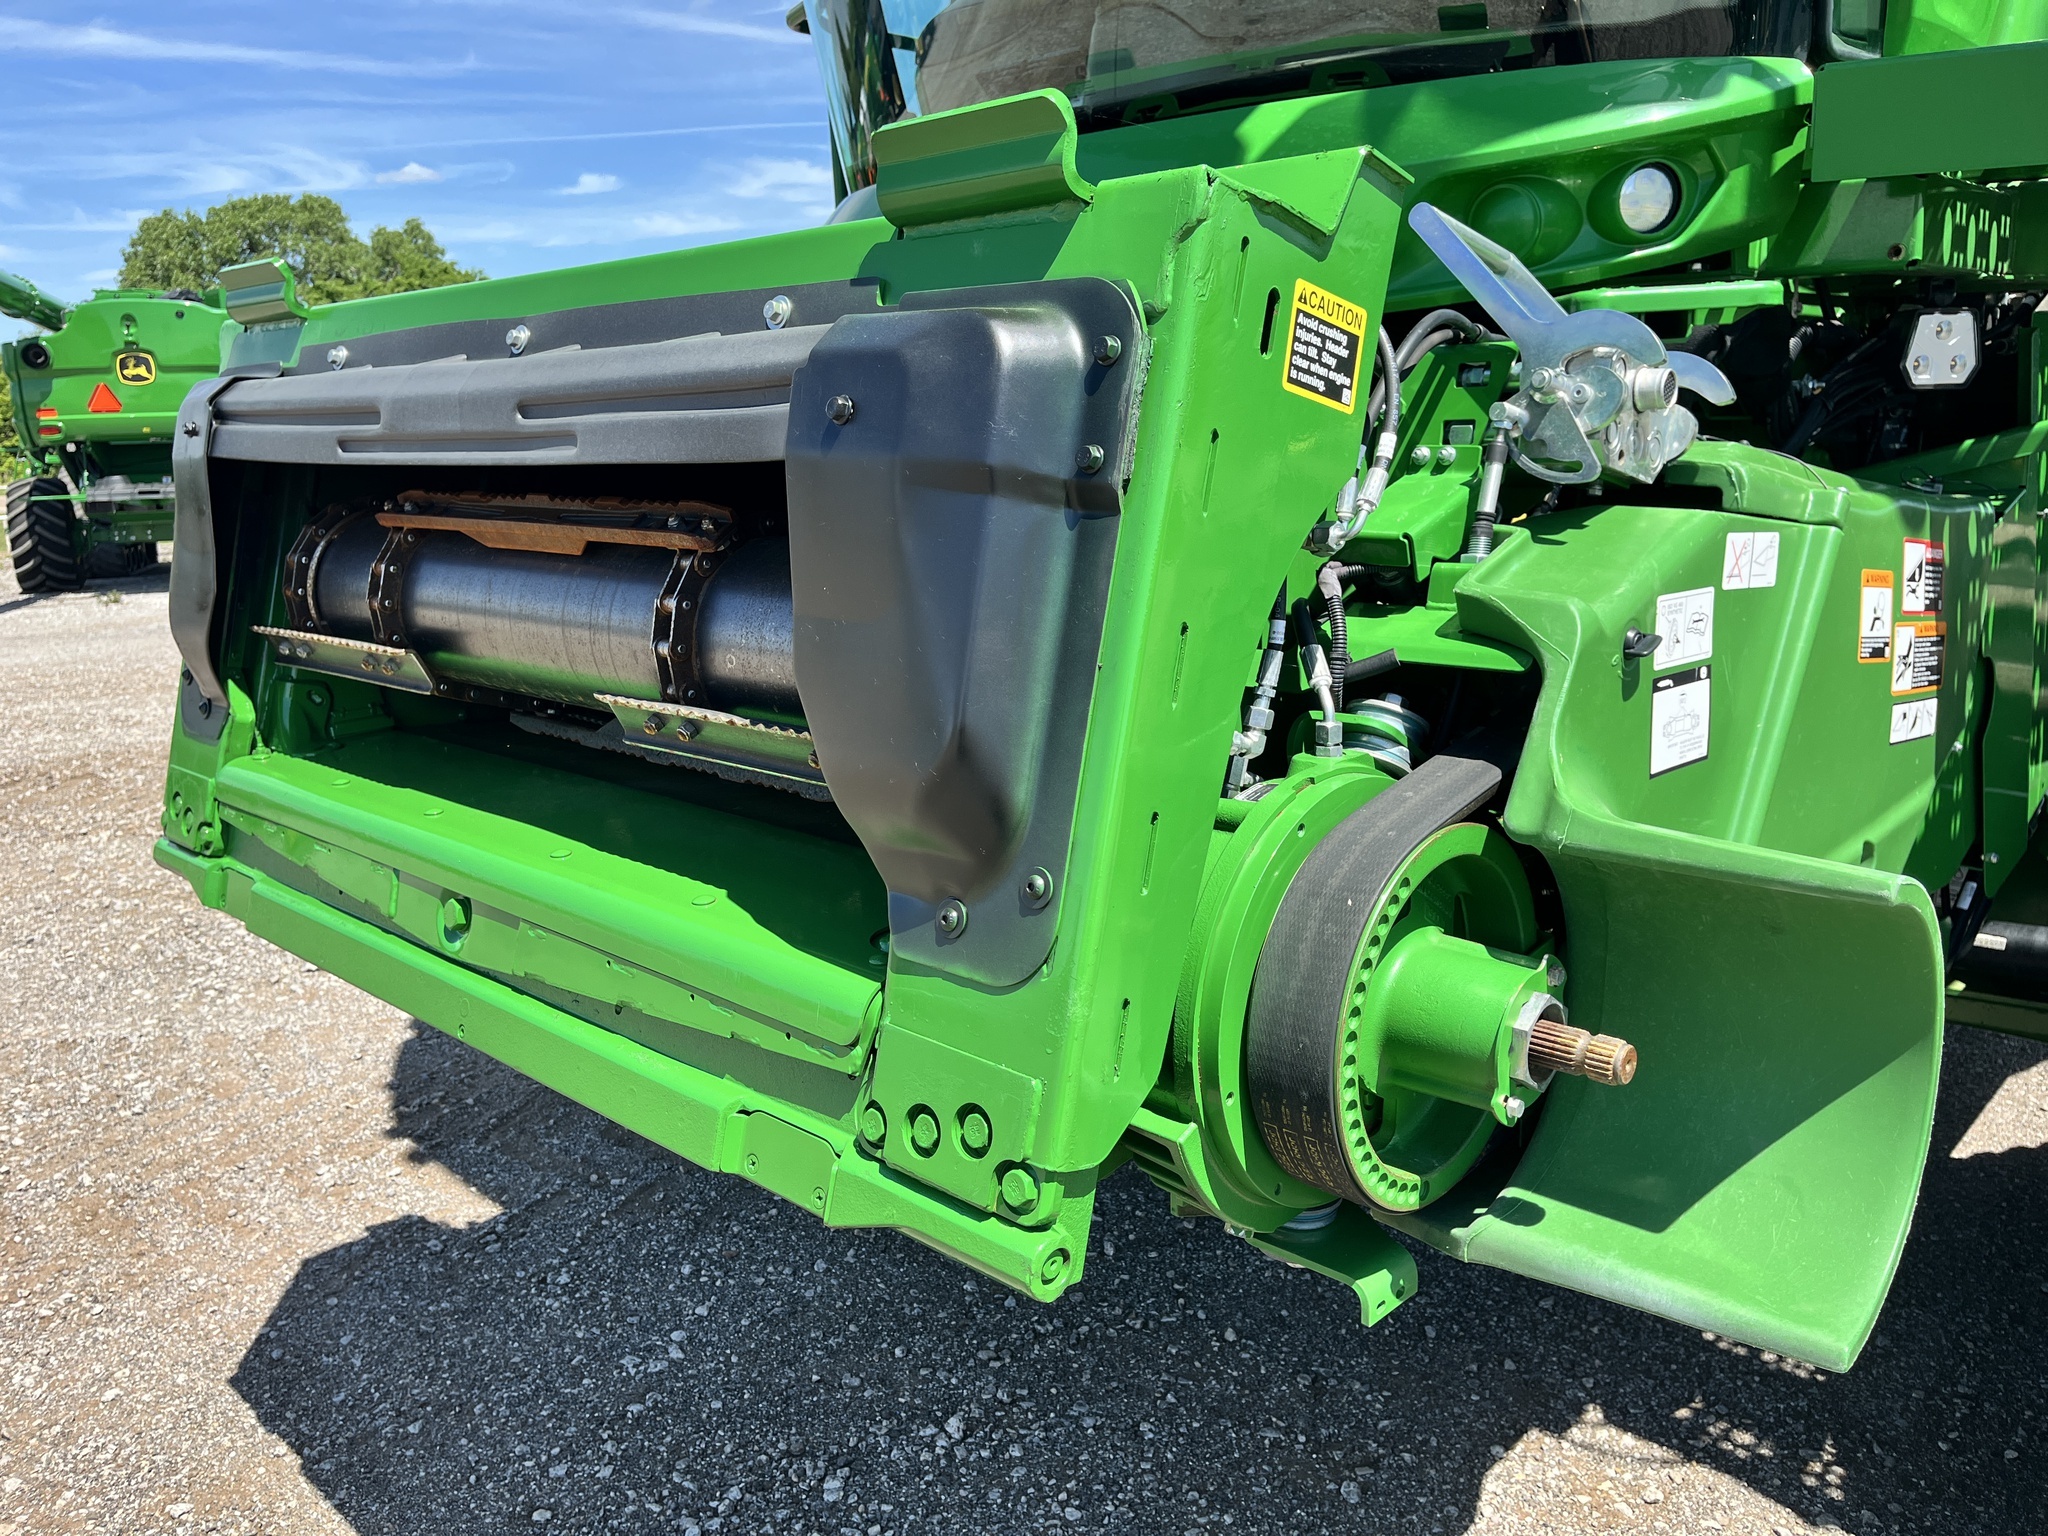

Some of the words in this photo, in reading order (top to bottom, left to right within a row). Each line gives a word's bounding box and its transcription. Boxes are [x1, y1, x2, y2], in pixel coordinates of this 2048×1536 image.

[1309, 291, 1363, 330] CAUTION
[1295, 325, 1323, 348] injuries.
[1325, 338, 1350, 359] Header
[1297, 312, 1319, 332] Avoid
[1318, 323, 1348, 347] crushing
[1291, 354, 1310, 370] clear
[1309, 362, 1329, 378] when
[1328, 370, 1352, 387] engine
[1293, 341, 1308, 355] can
[1307, 345, 1319, 360] tilt.
[1321, 350, 1338, 370] Stay
[1289, 366, 1298, 379] is
[1297, 371, 1326, 392] running.
